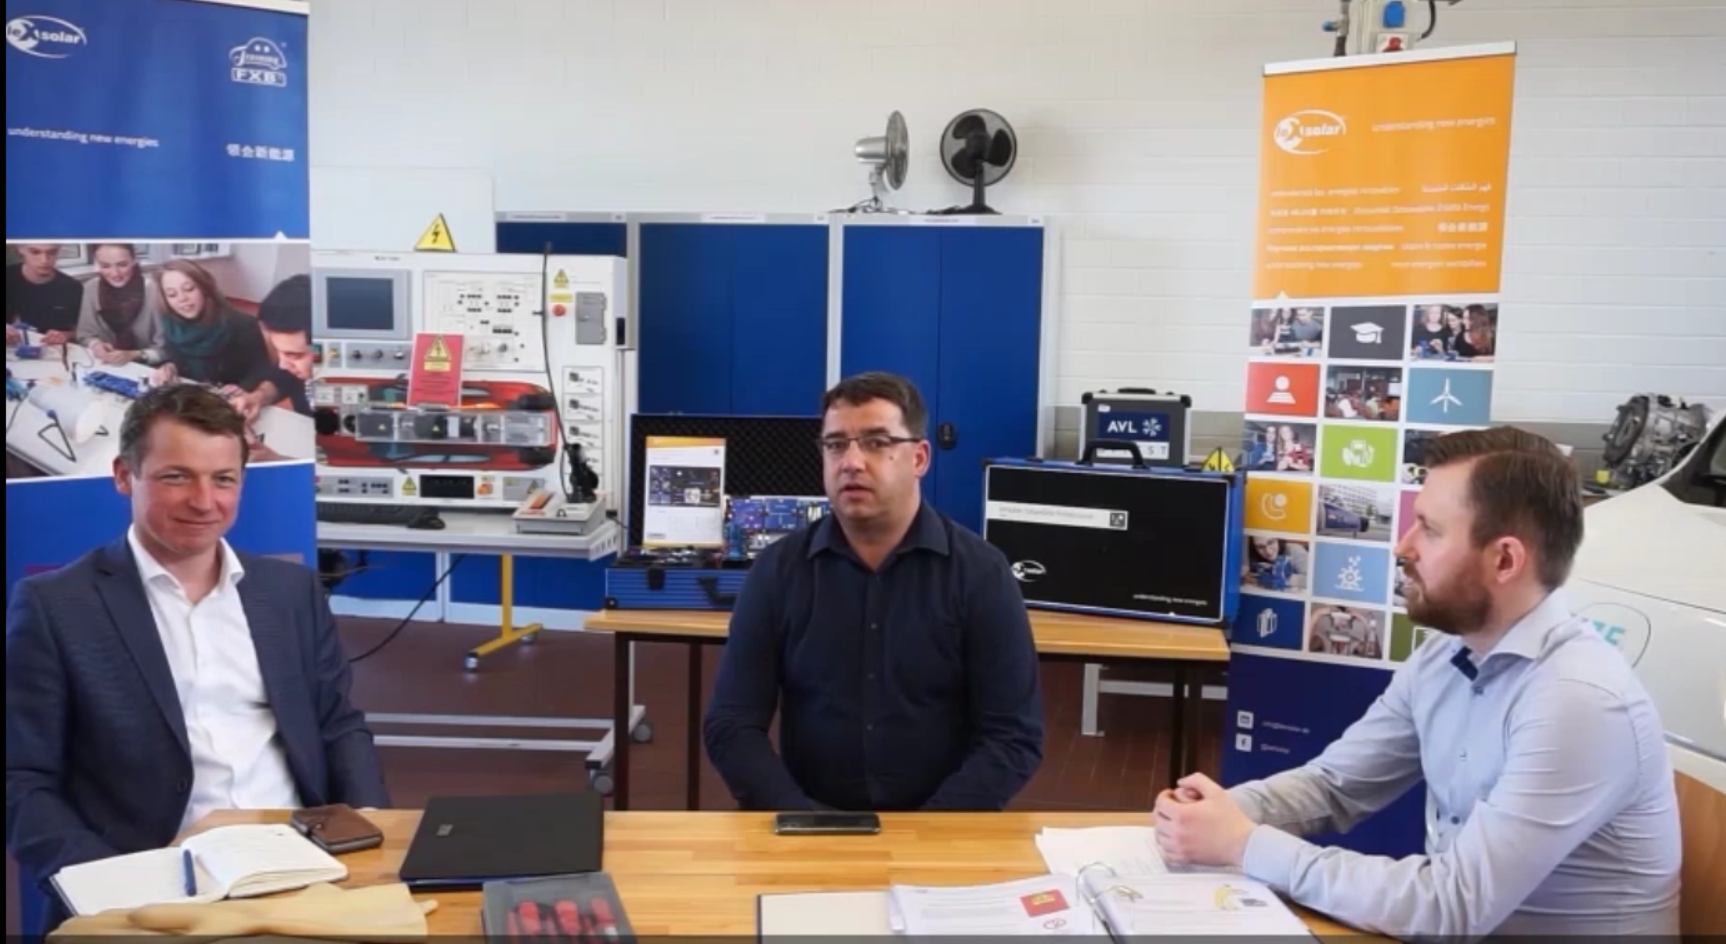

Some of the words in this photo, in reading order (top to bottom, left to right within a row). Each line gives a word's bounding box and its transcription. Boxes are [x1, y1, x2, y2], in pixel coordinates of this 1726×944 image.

[7, 126, 89, 144] understanding
[89, 134, 112, 144] new
[114, 135, 160, 149] energies
[1106, 420, 1138, 434] AVL
